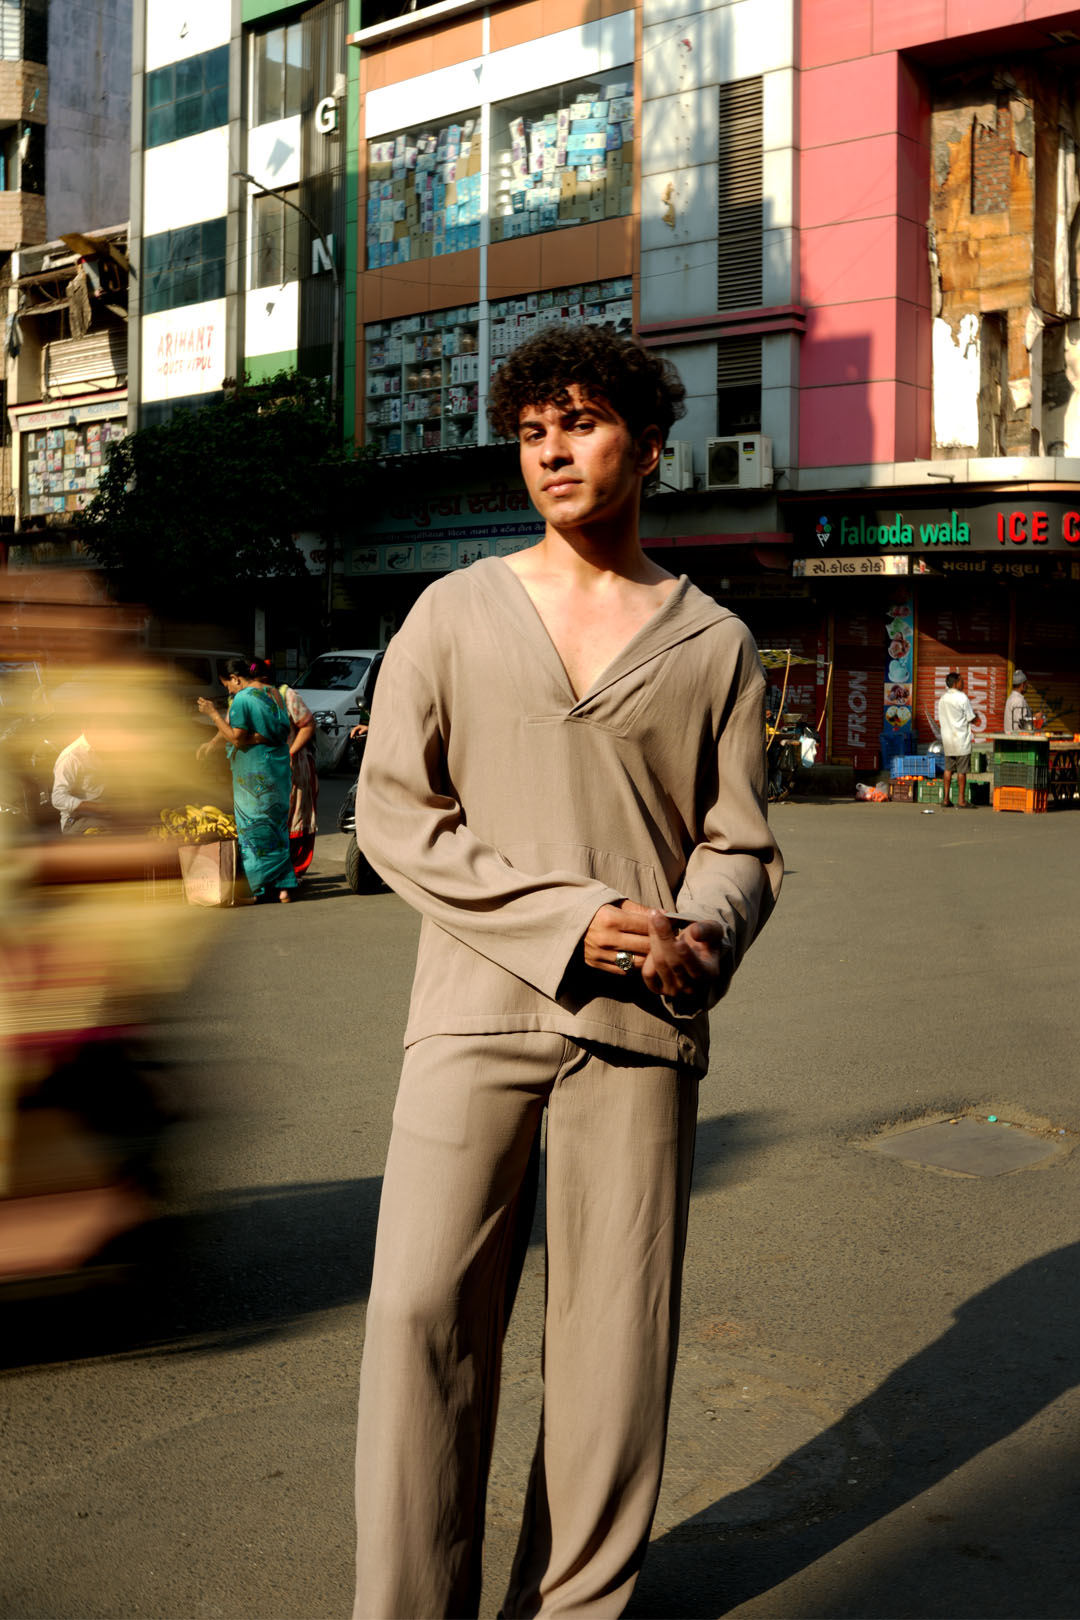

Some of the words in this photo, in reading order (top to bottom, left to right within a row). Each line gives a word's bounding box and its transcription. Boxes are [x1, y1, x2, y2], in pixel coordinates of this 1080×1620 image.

[315, 97, 338, 133] G
[312, 233, 336, 274] N
[158, 325, 214, 357] ARIHANT
[920, 510, 970, 544] wala
[997, 511, 1048, 543] ICE
